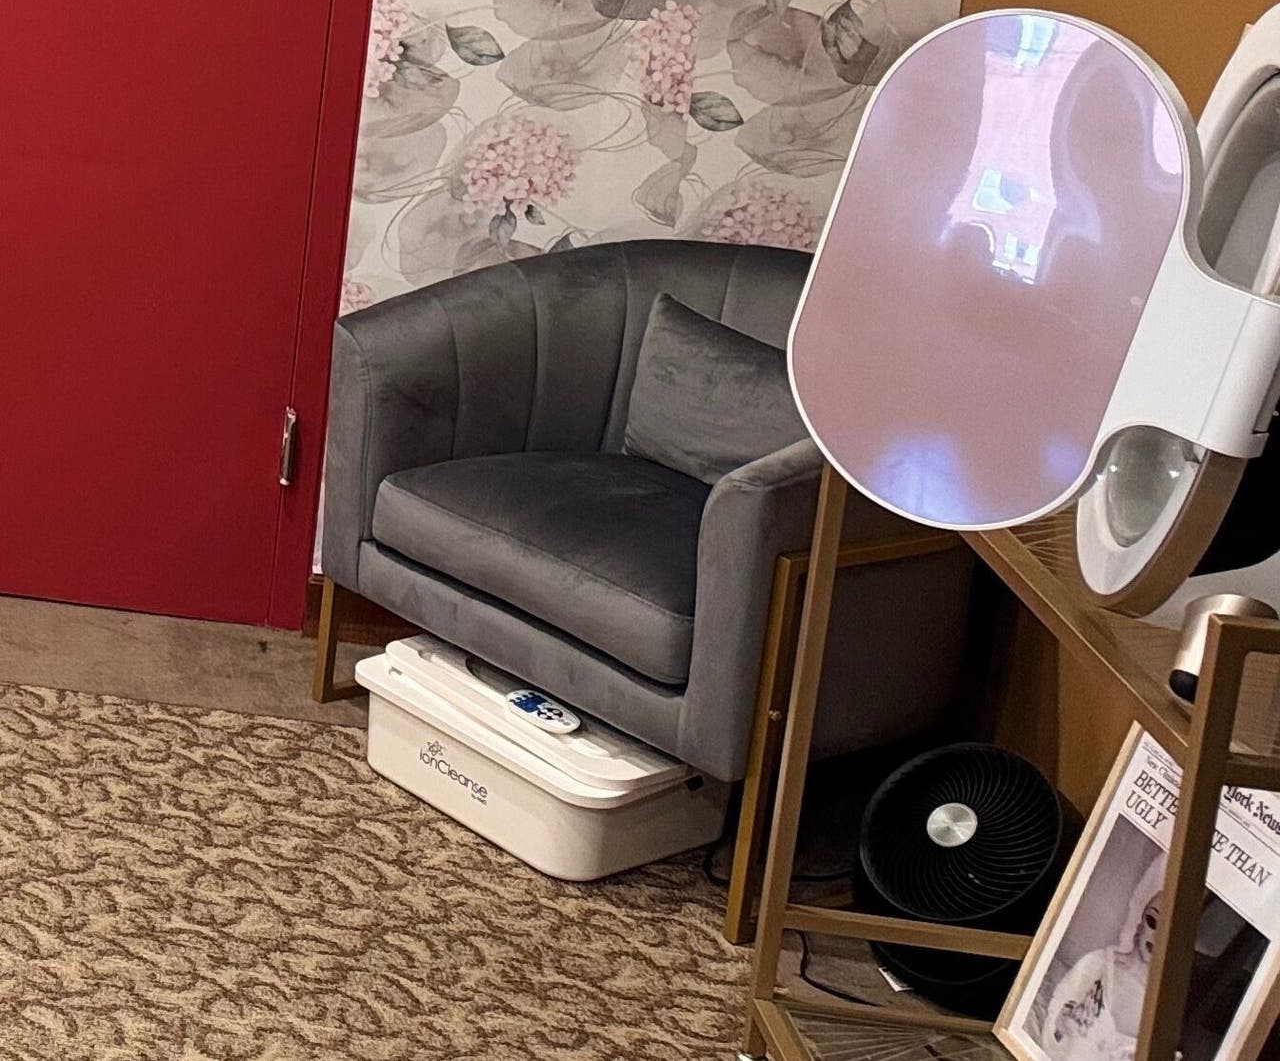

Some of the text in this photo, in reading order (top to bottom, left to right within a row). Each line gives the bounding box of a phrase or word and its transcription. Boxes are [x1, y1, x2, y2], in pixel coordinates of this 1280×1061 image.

[419, 748, 489, 799] IonCleanse
[1126, 789, 1168, 829] UGLY
[1133, 769, 1180, 816] BETTE
[1224, 843, 1273, 887] THAN
